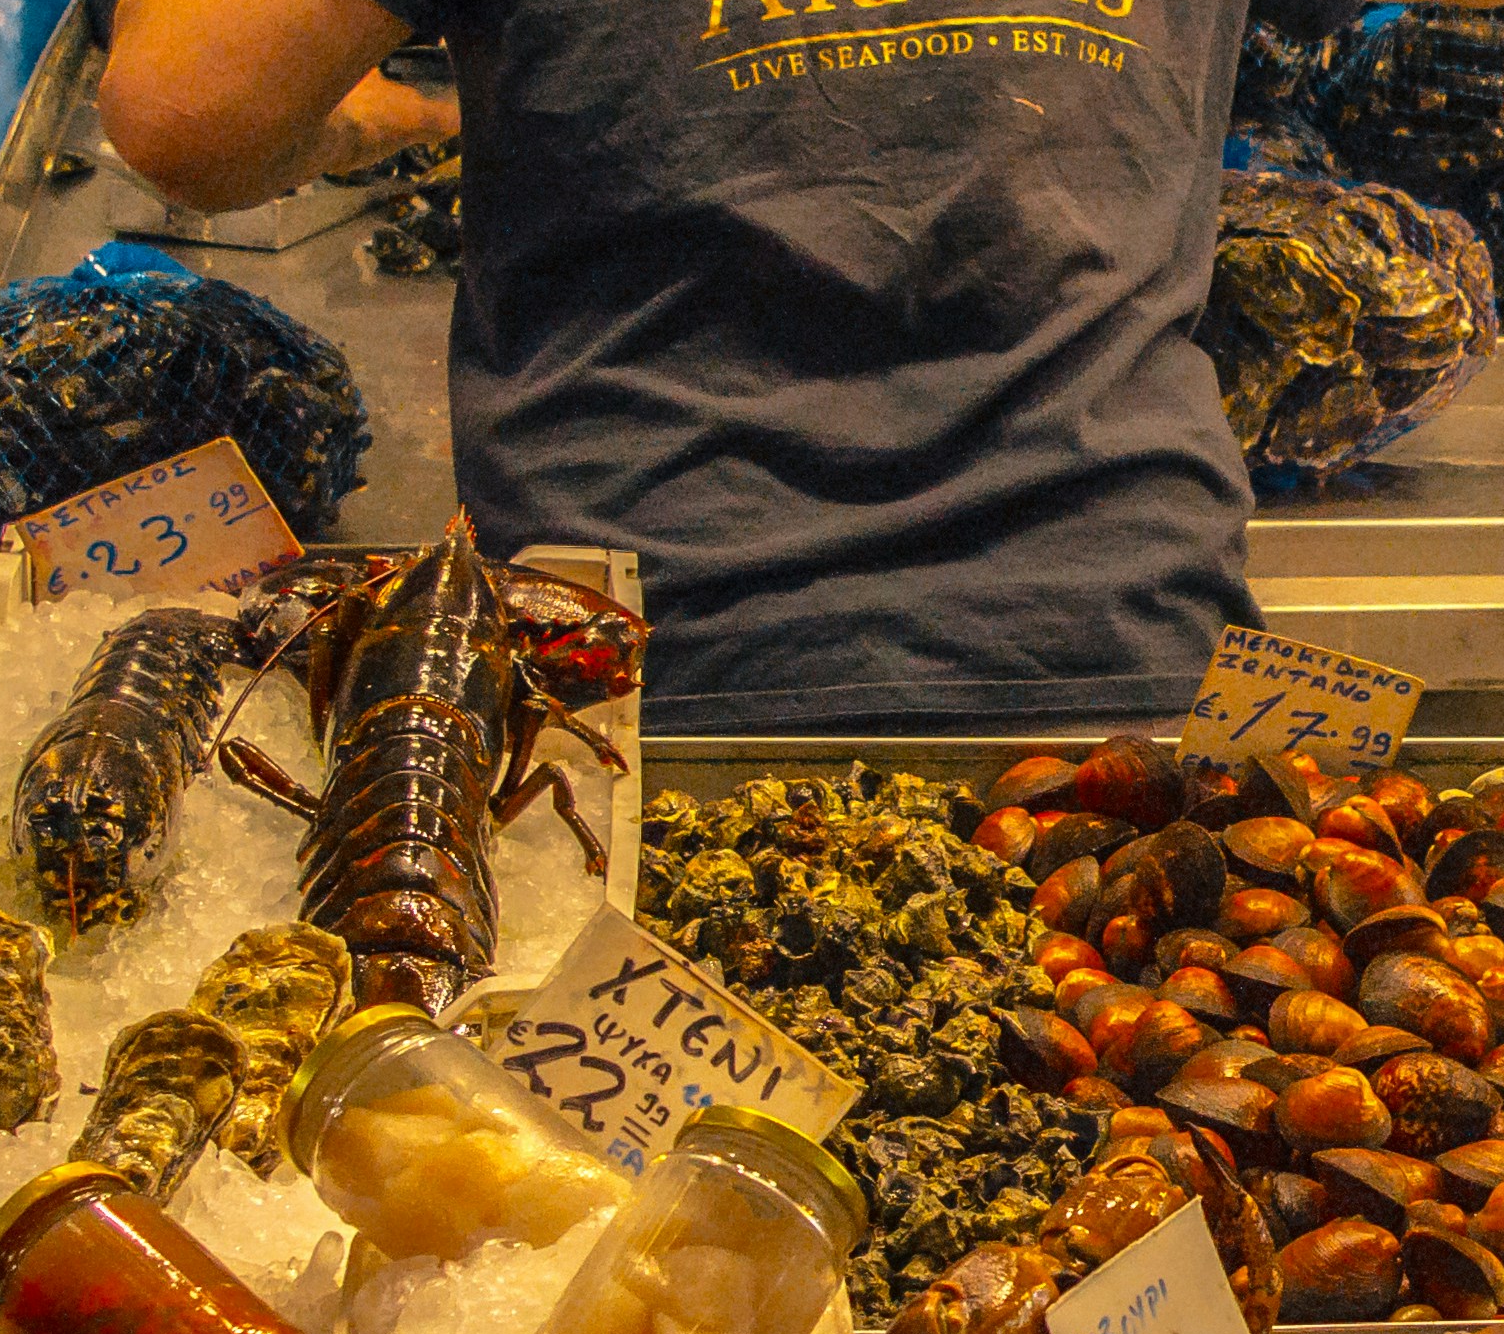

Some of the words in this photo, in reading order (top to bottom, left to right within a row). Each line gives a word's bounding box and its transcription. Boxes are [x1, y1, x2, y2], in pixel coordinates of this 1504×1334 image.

[727, 53, 807, 92] LIVE
[818, 31, 974, 70] SEAFOOD
[1012, 29, 1070, 57] EST.
[1078, 39, 1126, 74] 1944
[24, 456, 197, 541] ΑΣΤΑΚΟΣ
[1216, 651, 1372, 703] ΖΩΝΤΑΝΟ
[588, 956, 783, 1102] ΧΤΕΝΙ
[592, 1012, 673, 1086] ΨΥΧΑ
